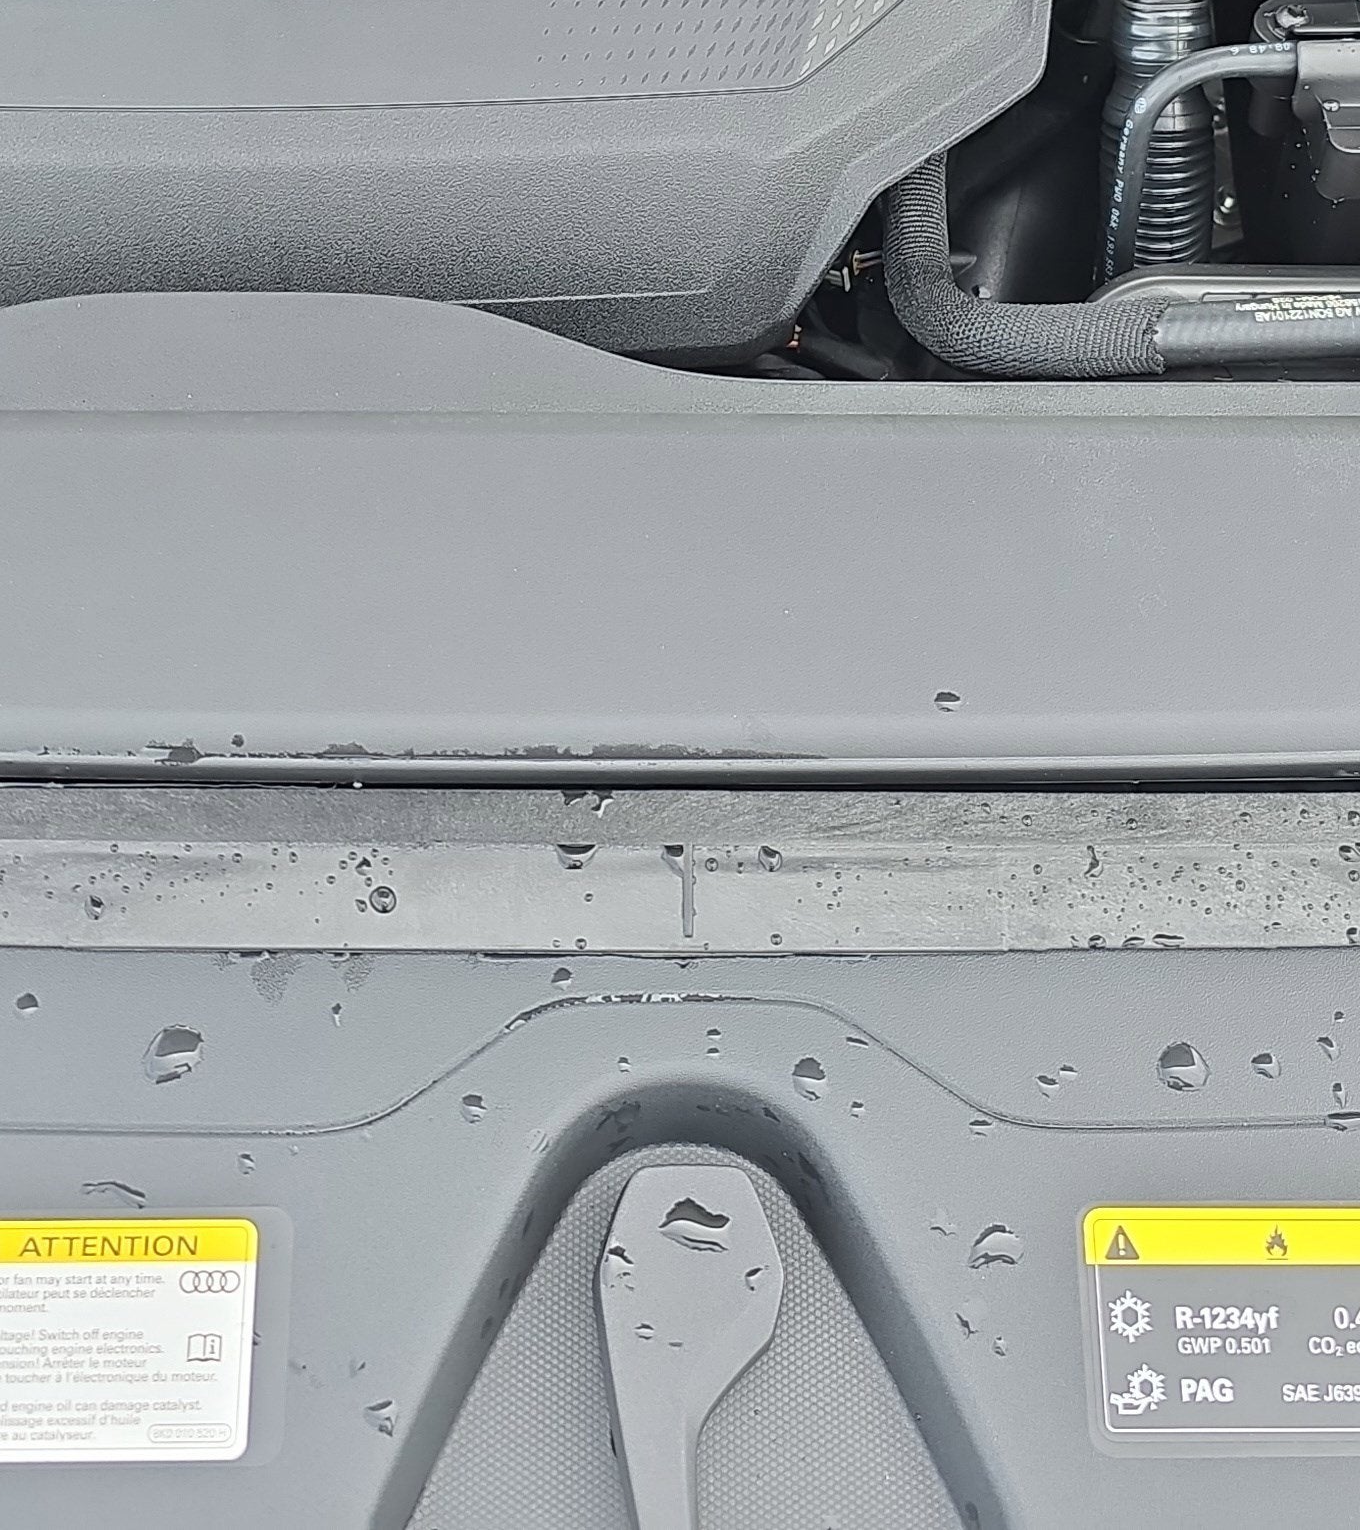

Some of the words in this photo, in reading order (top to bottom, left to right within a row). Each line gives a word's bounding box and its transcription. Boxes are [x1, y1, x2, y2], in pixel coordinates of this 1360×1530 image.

[1115, 119, 1134, 174] Germany
[1235, 303, 1281, 312] Hungary
[1294, 300, 1325, 309] Made
[1335, 307, 1352, 318] AG
[18, 1234, 199, 1257] ATTENTION
[13, 1274, 34, 1285] fan
[36, 1276, 60, 1288] may
[65, 1274, 93, 1285] start
[96, 1274, 107, 1284] at
[110, 1275, 133, 1287] any
[137, 1273, 165, 1284] time.
[42, 1288, 70, 1301] peut
[72, 1289, 86, 1298] se
[90, 1286, 156, 1298] déclencher
[1174, 1306, 1280, 1334] R-1234yf
[39, 1329, 80, 1340] Switch
[83, 1328, 100, 1340] off
[103, 1330, 144, 1342] engine
[51, 1344, 93, 1357] engine
[1177, 1338, 1223, 1355] GWP
[1225, 1337, 1271, 1354] 0.501
[43, 1356, 86, 1368] Arrêter
[89, 1357, 100, 1368] le
[103, 1358, 147, 1368] moteur
[4, 1372, 51, 1383] toucher
[152, 1371, 167, 1382] du
[1180, 1379, 1235, 1402] PAG
[1282, 1385, 1320, 1402] SAE
[12, 1401, 54, 1414] engine
[56, 1400, 71, 1411] oil
[74, 1402, 98, 1411] can
[100, 1400, 149, 1413] damage
[47, 1414, 96, 1426] excessif
[12, 1431, 27, 1441] au
